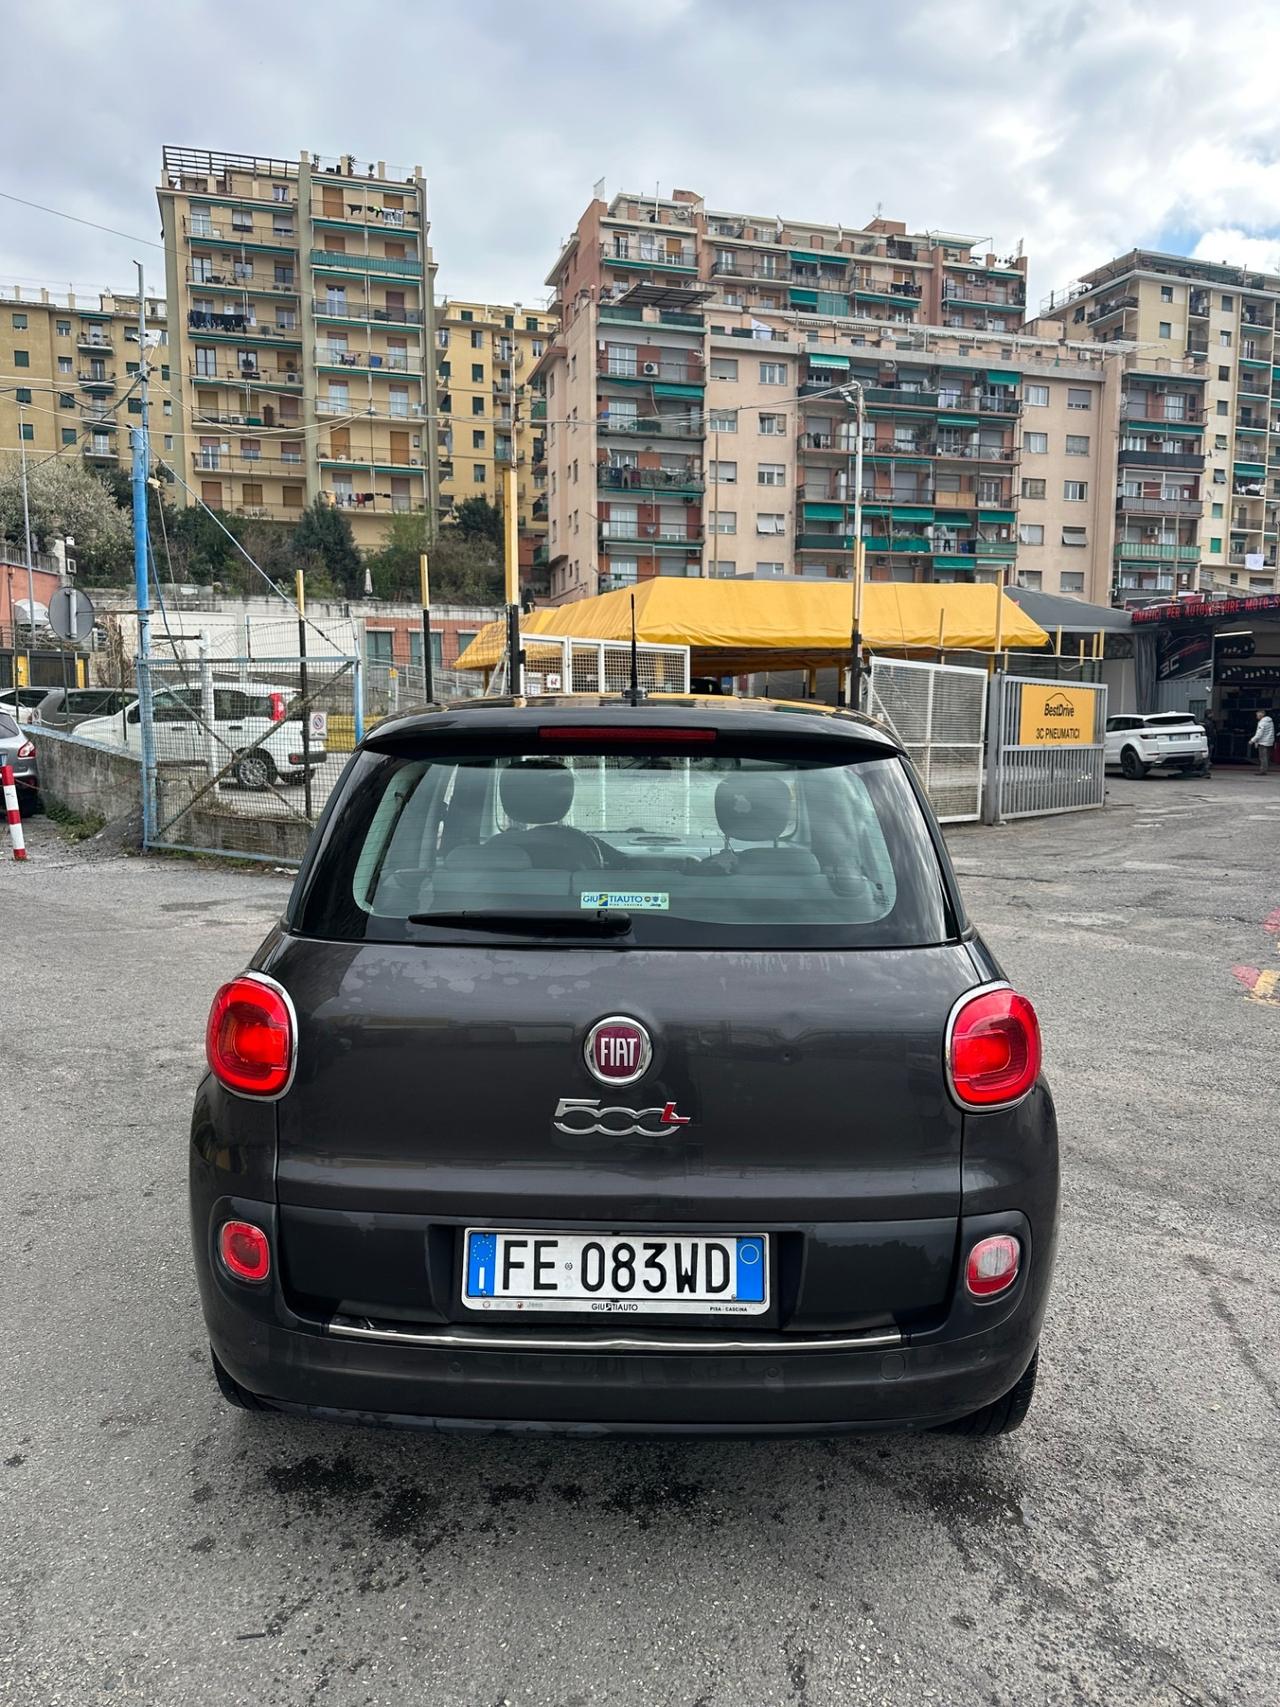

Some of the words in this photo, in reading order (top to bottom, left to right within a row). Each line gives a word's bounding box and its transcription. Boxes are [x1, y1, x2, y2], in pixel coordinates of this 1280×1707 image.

[1167, 607, 1180, 618] PER
[1044, 703, 1075, 717] BestDrive
[1036, 728, 1044, 739] 3C
[1045, 728, 1080, 739] PNEUMATICI
[600, 1037, 638, 1067] FIAT
[553, 1098, 691, 1137] 500L
[502, 1240, 559, 1291] FE
[580, 1241, 731, 1294] 083WD
